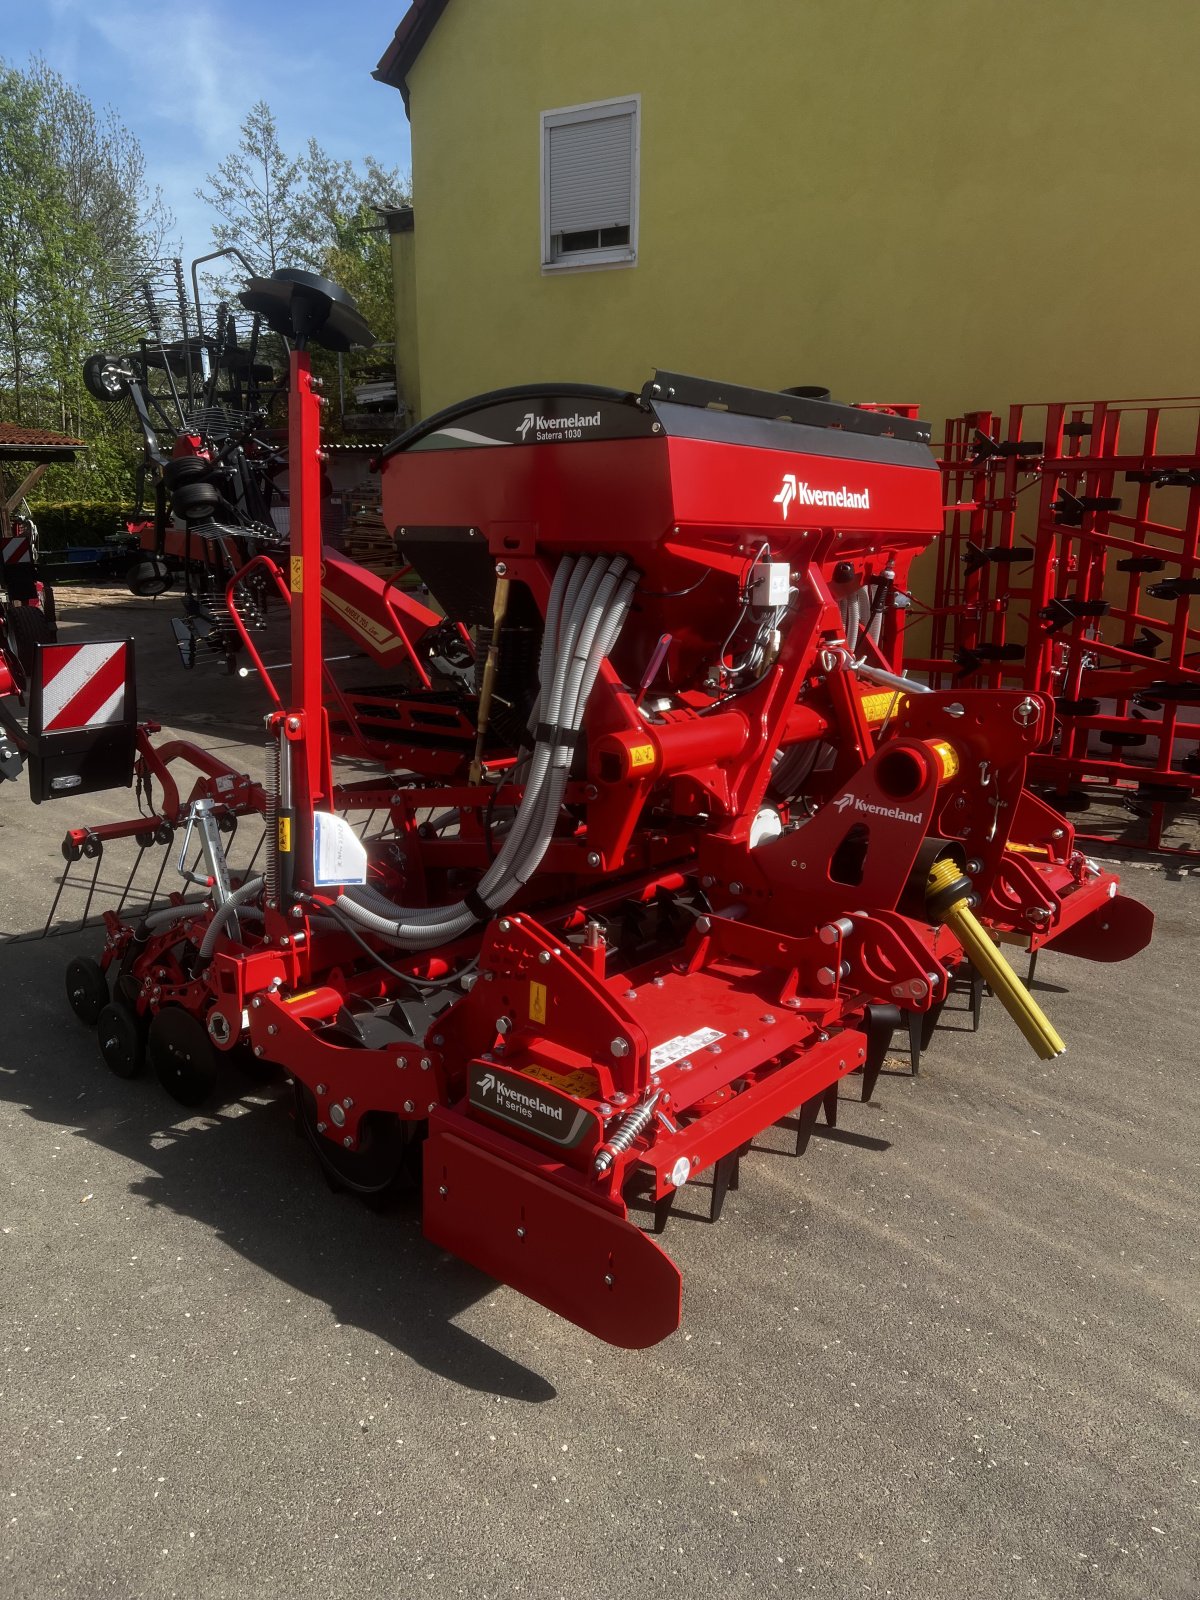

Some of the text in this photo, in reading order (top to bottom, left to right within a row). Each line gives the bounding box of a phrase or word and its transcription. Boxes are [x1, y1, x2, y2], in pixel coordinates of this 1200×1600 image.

[536, 411, 601, 430] Kverneland
[536, 429, 582, 441] Saterra 1030
[798, 481, 870, 509] Kverneland
[854, 798, 923, 824] Kverneland
[496, 1080, 563, 1121] Kverneland
[496, 1094, 533, 1118] H series
